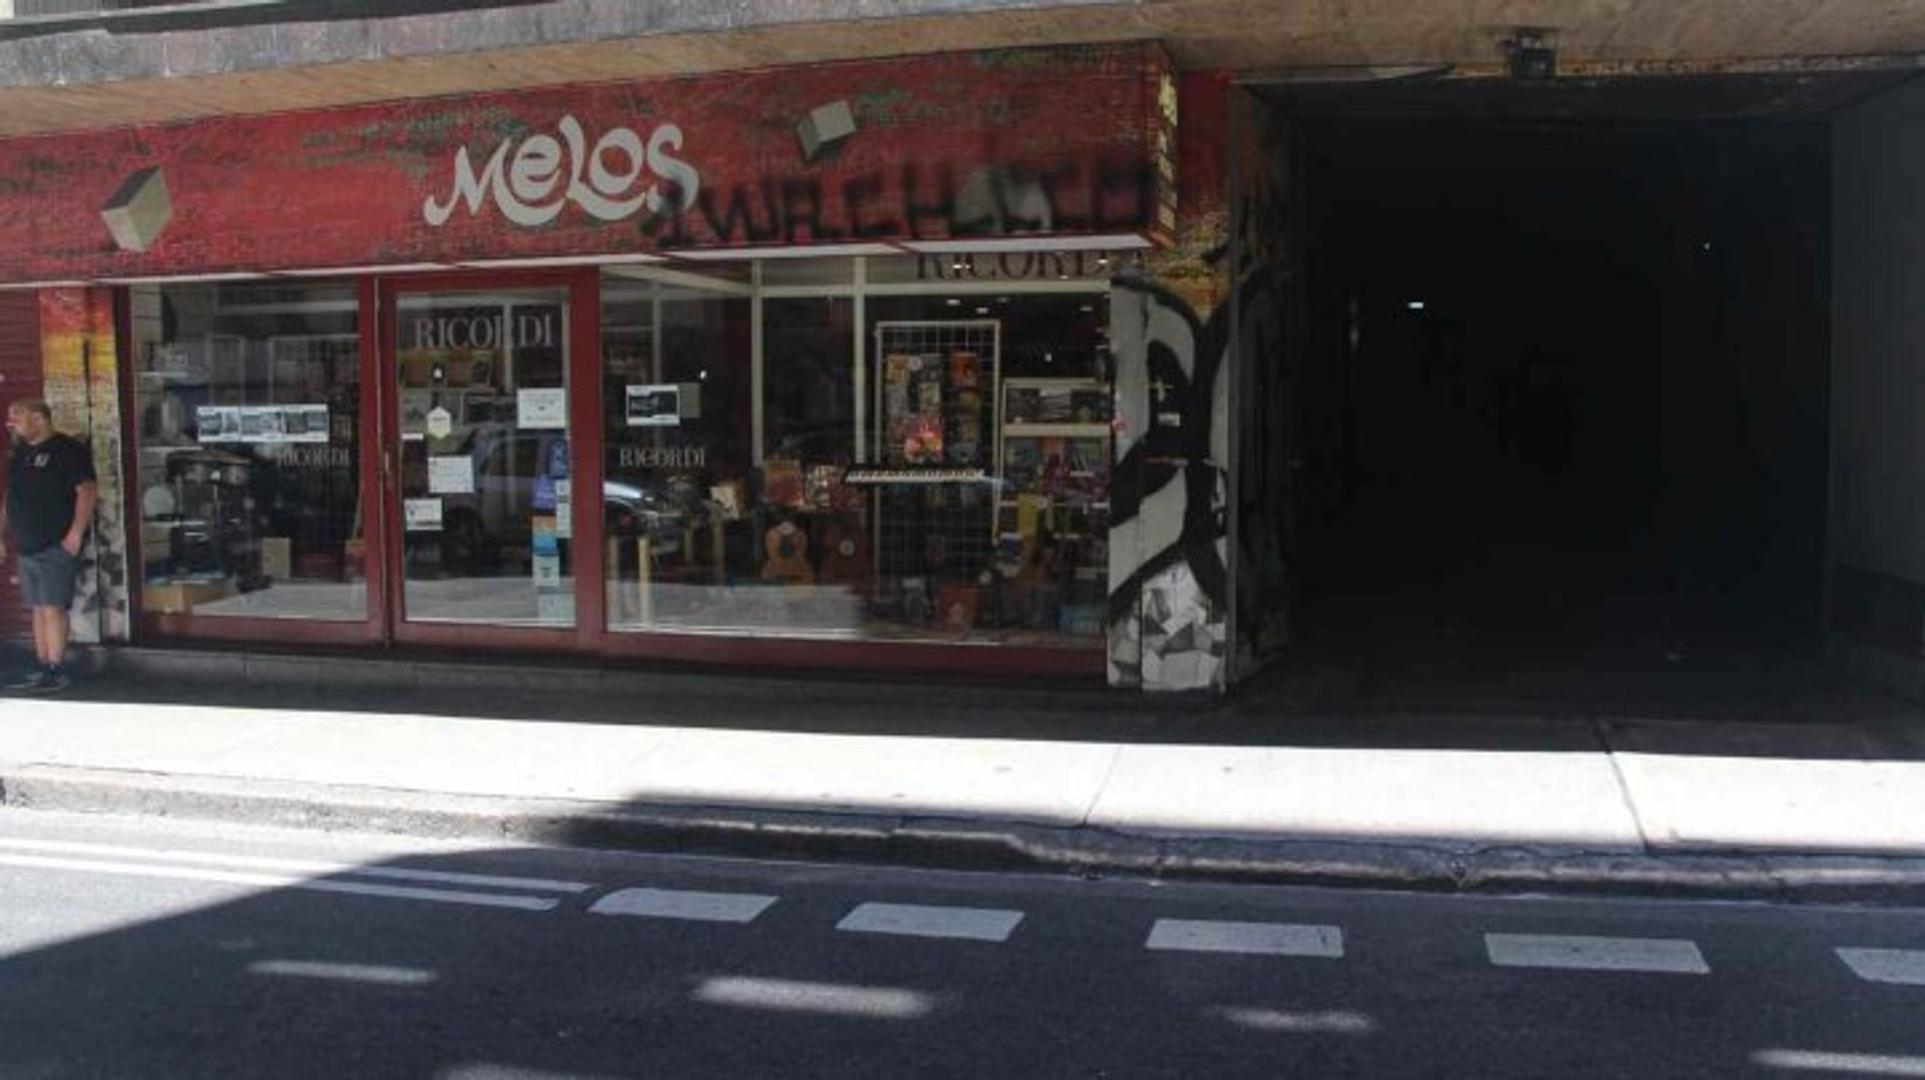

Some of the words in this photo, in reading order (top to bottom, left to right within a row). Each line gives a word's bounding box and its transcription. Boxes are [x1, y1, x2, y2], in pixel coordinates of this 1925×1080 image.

[916, 251, 1144, 280] RICORD
[414, 314, 554, 350] RICORDI
[618, 445, 707, 469] RICORDI
